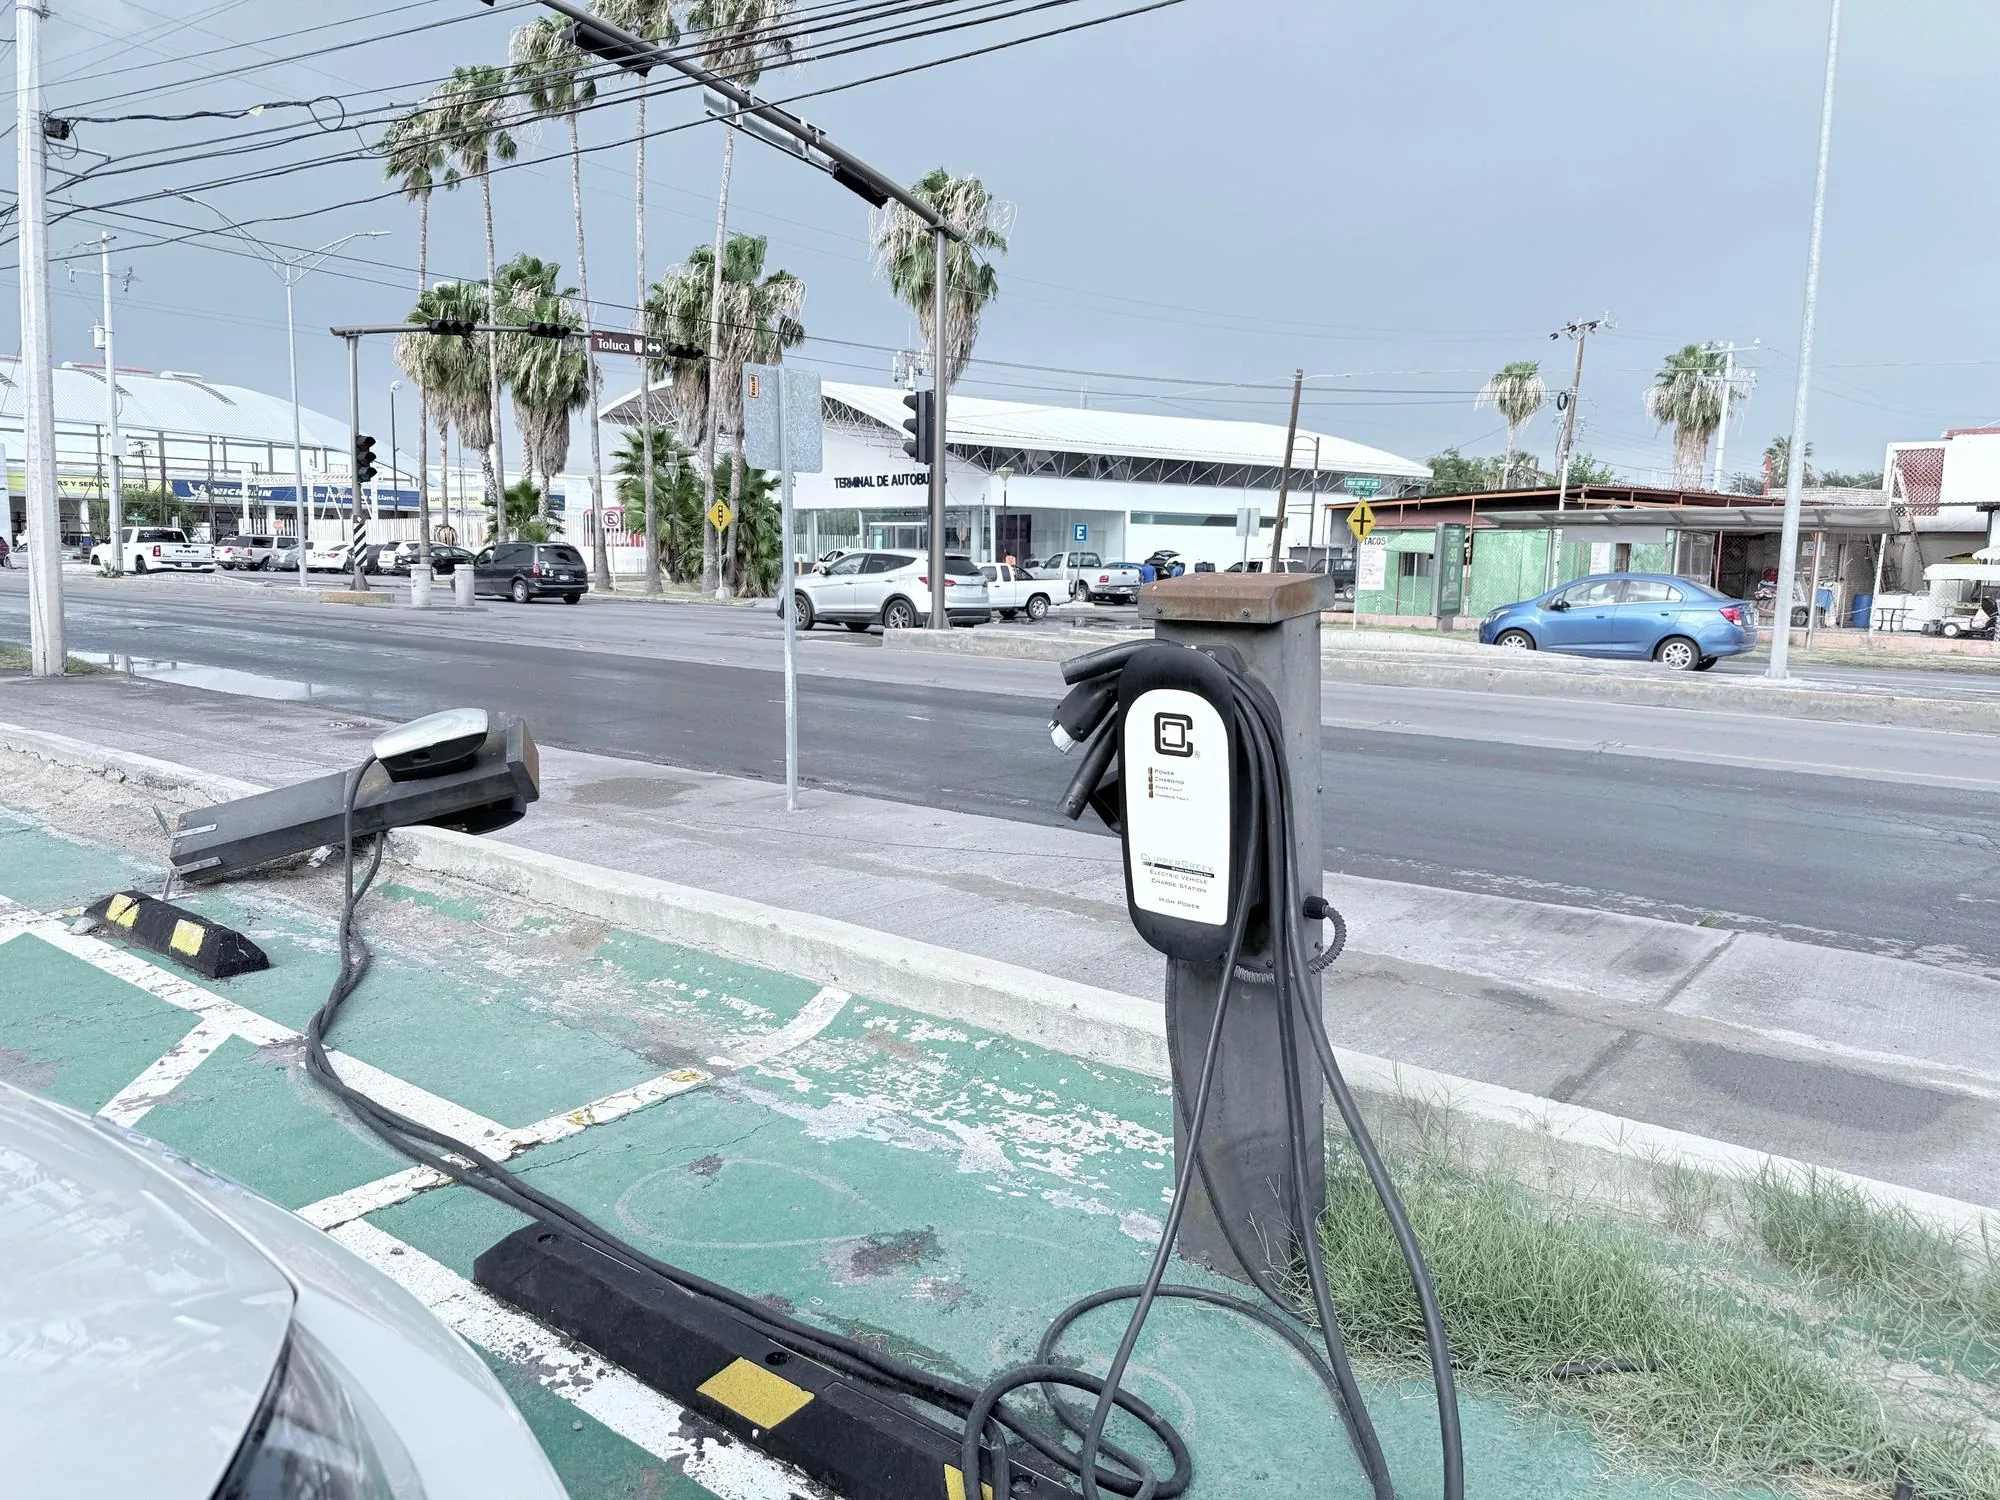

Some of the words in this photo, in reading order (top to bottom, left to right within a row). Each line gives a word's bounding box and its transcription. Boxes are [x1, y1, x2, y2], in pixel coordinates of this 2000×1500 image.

[597, 338, 630, 352] Toluca
[834, 477, 875, 489] TERMINAL
[877, 475, 889, 487] DE
[891, 472, 947, 486] AUTOBU
[1077, 526, 1085, 540] E
[1363, 536, 1387, 546] TACOS
[1151, 877, 1177, 888] CHARGE
[1179, 883, 1207, 893] STATION
[1158, 896, 1175, 905] HIGH
[1177, 899, 1200, 910] POWER
